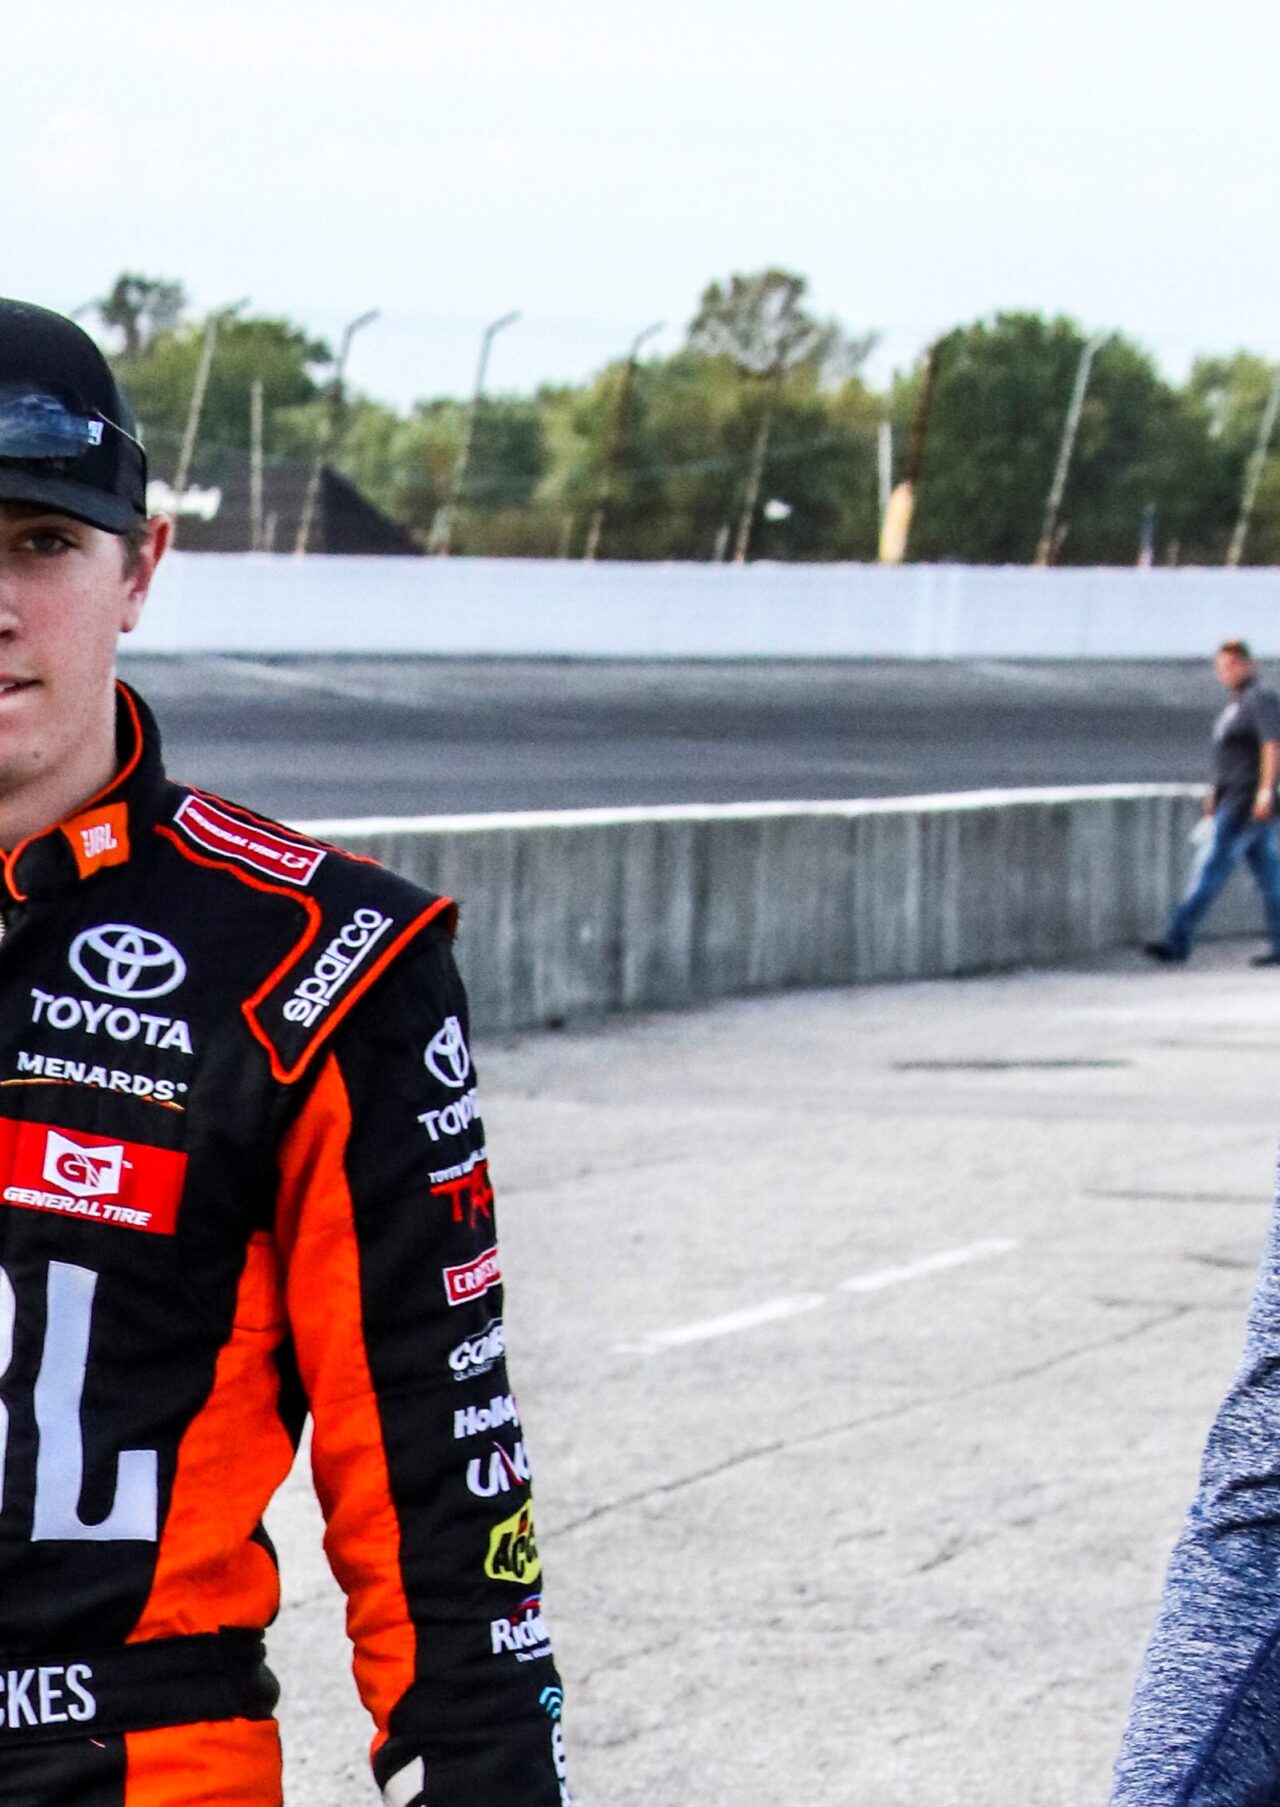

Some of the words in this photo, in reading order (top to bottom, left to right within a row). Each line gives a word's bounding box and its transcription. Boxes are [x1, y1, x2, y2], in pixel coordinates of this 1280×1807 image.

[80, 823, 117, 858] JBL
[283, 908, 386, 1026] sparco
[30, 988, 194, 1054] TOYOTA
[17, 1050, 180, 1101] MENARDS
[56, 1152, 113, 1187] GT
[3, 1186, 102, 1217] GENERAL
[102, 1204, 153, 1227] TIRE
